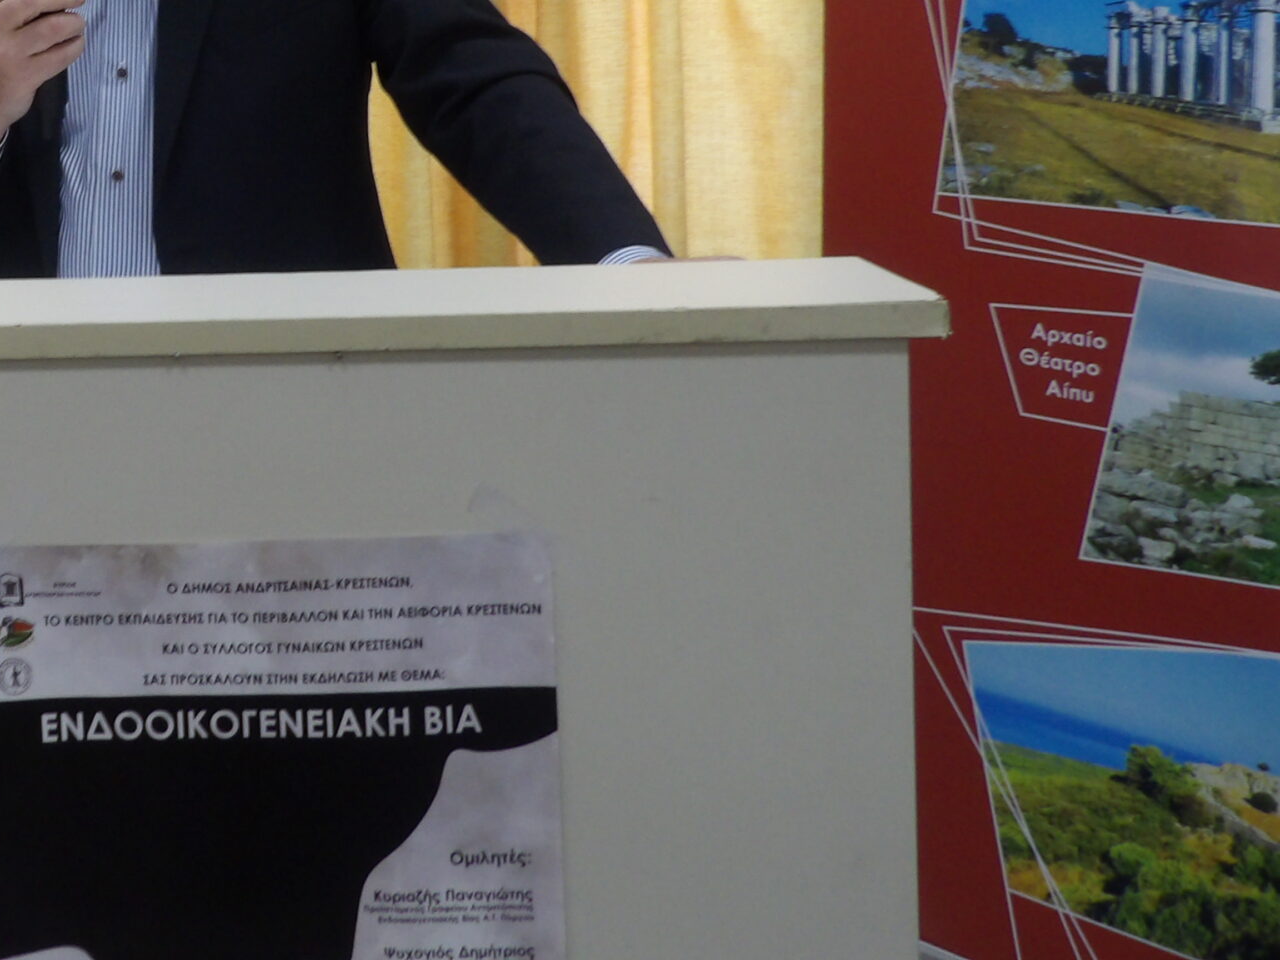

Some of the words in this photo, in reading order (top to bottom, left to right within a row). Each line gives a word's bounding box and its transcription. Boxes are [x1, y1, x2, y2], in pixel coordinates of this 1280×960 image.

[1031, 322, 1108, 349] Αρχαίο
[1019, 347, 1101, 378] Θέατρο
[1045, 379, 1095, 403] Αίπυ
[181, 581, 231, 594] ΔΗΜΟΣ
[44, 615, 61, 627] ΤΟ
[64, 614, 114, 627] ΚΕΝΤΡΟ
[118, 612, 204, 626] ΕΚΠΑΙΔΕΥΣΗΣ
[207, 611, 227, 624] ΓΙΑ
[231, 610, 249, 624] ΤΟ
[253, 608, 338, 624] ΠΕΡΙΒΑΛΛΟΝ
[342, 607, 365, 621] ΚΑΙ
[368, 606, 393, 619] ΤΗΝ
[397, 603, 462, 619] ΑΕΙΦΟΡΙΑ
[466, 601, 542, 617] ΚΡΕΣΤΕΝΩΝ
[162, 642, 185, 655] ΚΑΙ
[203, 640, 272, 655] ΣΥΛΛΟΓΟΣ
[277, 639, 345, 654] ΓΥΝΑΙΚΩΝ
[349, 636, 423, 651] ΚΡΕΣΤΕΝΩΝ
[143, 674, 167, 687] ΣΑΣ
[171, 671, 262, 686] ΠΡΟΣΚΑΛΟΥΝ
[266, 672, 298, 685] ΣΤΗΝ
[302, 670, 374, 684] ΕΚΔΗΛΩΣΗ
[378, 669, 396, 682] ΜΕ
[40, 706, 411, 744] ΕΝΔΟΟΙΚΟΓΕΝΕΙΑΚΗ
[423, 704, 482, 736] ΒΙΑ
[450, 849, 532, 867] Ομιλητές:
[373, 888, 440, 907] Κυριαζής
[445, 886, 533, 904] Παναγιώτης
[459, 943, 536, 960] Δημήτριος
